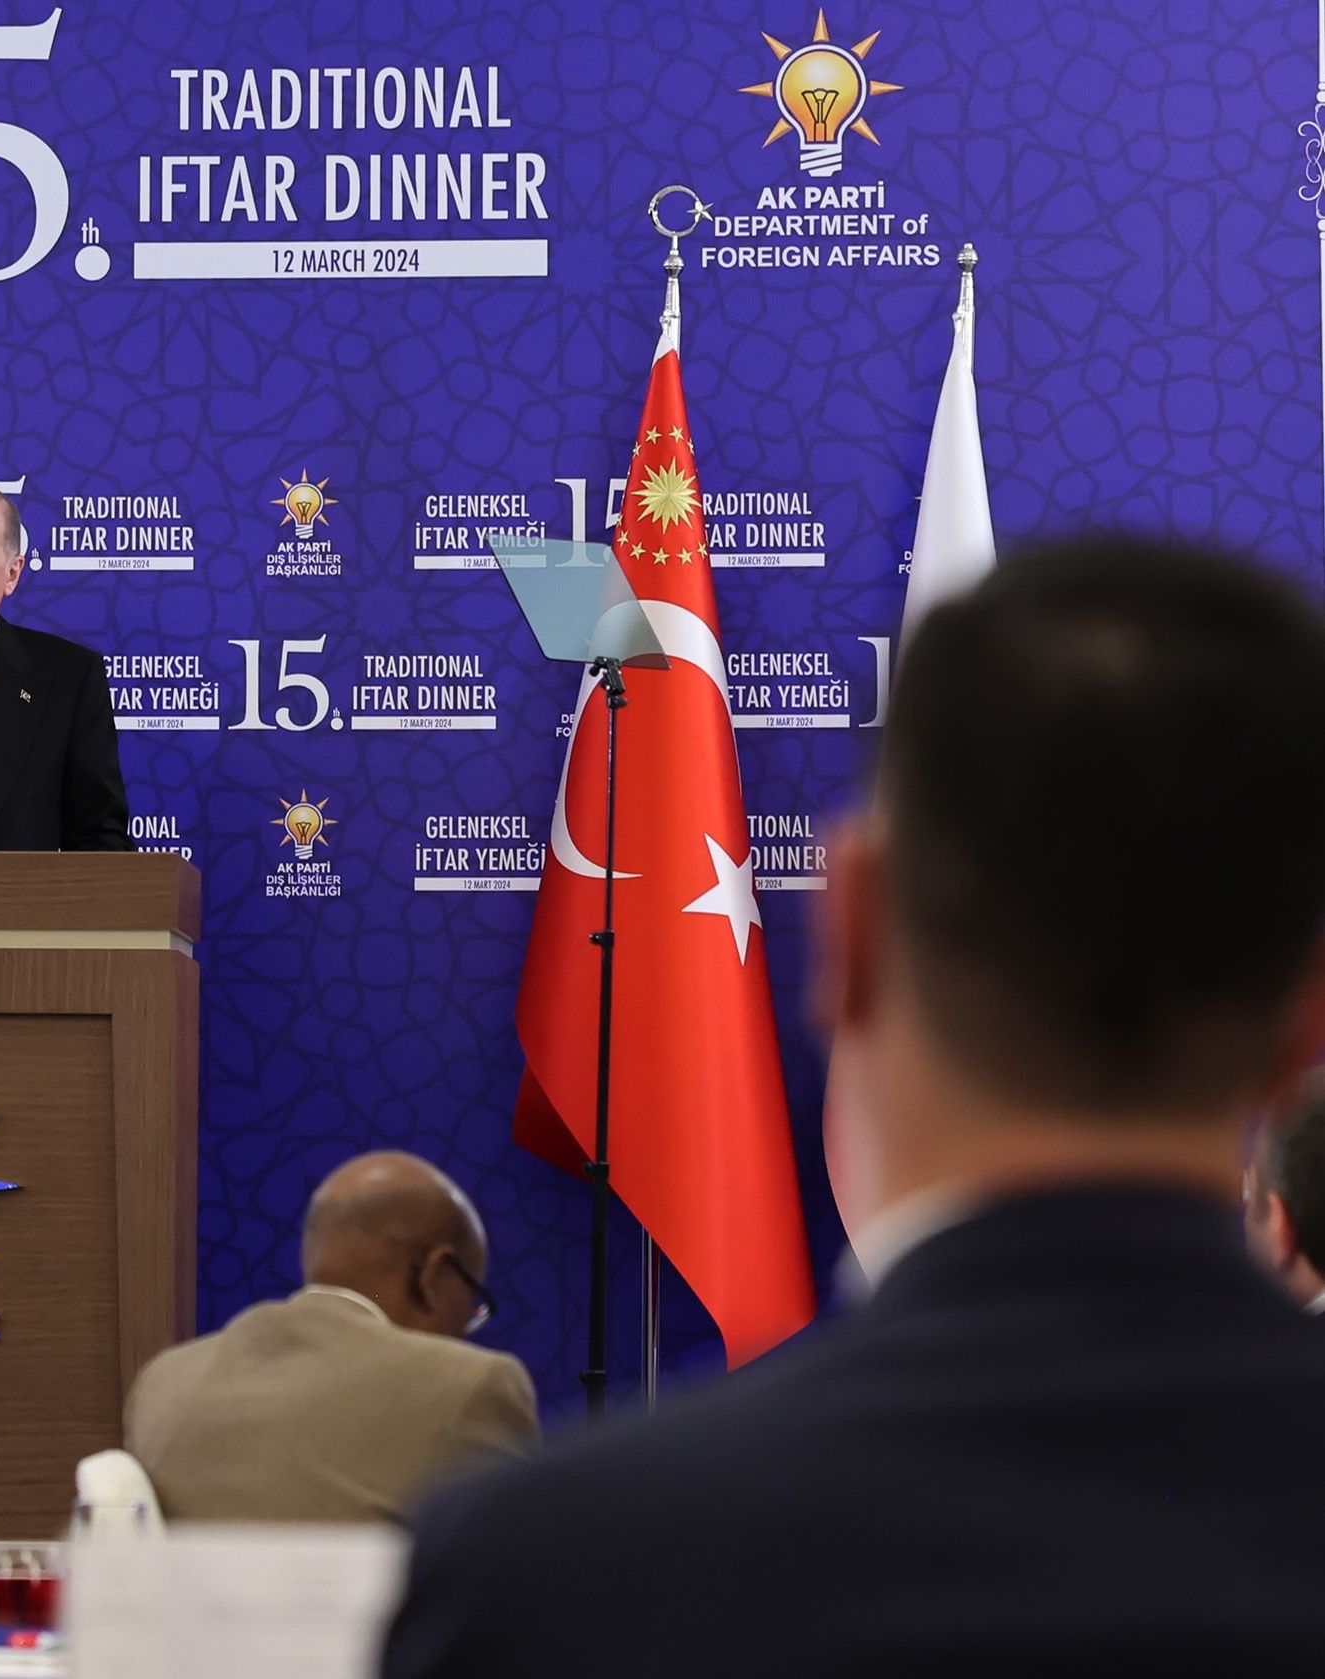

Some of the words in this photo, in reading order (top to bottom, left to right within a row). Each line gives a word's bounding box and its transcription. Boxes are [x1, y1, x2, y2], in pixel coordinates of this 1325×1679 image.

[170, 66, 511, 131] TRADITIONAL
[139, 155, 298, 222] IFTAR
[325, 152, 549, 221] DINNER
[756, 186, 797, 210] AK
[804, 180, 885, 209] PARTİ
[81, 217, 100, 244] th
[714, 215, 896, 238] DEPARTMENT
[902, 213, 929, 235] of
[272, 249, 294, 273] 12
[301, 249, 365, 273] MARCH
[373, 248, 420, 272] 2024
[701, 245, 820, 268] FOREIGN
[826, 244, 940, 267] AFFAIRS
[62, 496, 182, 519] TRADITIONAL
[425, 494, 530, 518] GELENEKSEL
[703, 493, 812, 515] RADITIONAL
[51, 526, 108, 551] IFTAR
[116, 526, 194, 551] DINNER
[415, 522, 469, 550] İFTAR
[475, 520, 546, 550] YEMEĞİ
[746, 522, 825, 548] DINNER
[277, 542, 295, 555] AK
[296, 539, 331, 555] PARTİ
[97, 558, 107, 570] 12
[108, 558, 132, 570] MARCH
[133, 558, 150, 570] 2024
[265, 563, 342, 577] BAŞKANLIĞI
[266, 553, 285, 566] DIŞ
[287, 552, 342, 566] İLİŞKİLER
[463, 556, 472, 567] 12
[473, 556, 493, 567] MART
[728, 556, 736, 566] 12
[737, 556, 761, 566] MARCH
[763, 556, 781, 566] 2024
[363, 655, 484, 678] TRADITIONAL
[728, 653, 833, 676] GELENEKSEL
[109, 688, 143, 710] TAR
[149, 681, 219, 710] YEMEĞİ
[353, 685, 409, 710] IFTAR
[418, 685, 497, 710] DINNER
[777, 679, 849, 708] YEMEĞİ
[137, 719, 146, 728] 12
[147, 719, 165, 728] MART
[166, 719, 184, 728] 2024
[399, 718, 409, 728] 12
[409, 718, 433, 728] MARCH
[435, 718, 452, 728] 2024
[766, 717, 774, 727] 12
[775, 717, 794, 727] MART
[796, 717, 813, 727] 2024
[425, 816, 531, 839] GELENEKSEL
[747, 815, 814, 838] TIONAL
[276, 862, 294, 876] AK
[296, 860, 331, 876] PARTİ
[415, 843, 470, 871] İFTAR
[475, 842, 545, 870] YEMEĞİ
[265, 884, 342, 898] BAŞKANLIĞI
[266, 875, 285, 887] DIŞ
[287, 873, 342, 887] İLİŞKİLER
[463, 880, 472, 890] 12
[473, 880, 493, 890] MART
[493, 880, 511, 890] 2024
[764, 879, 783, 889] 2024
